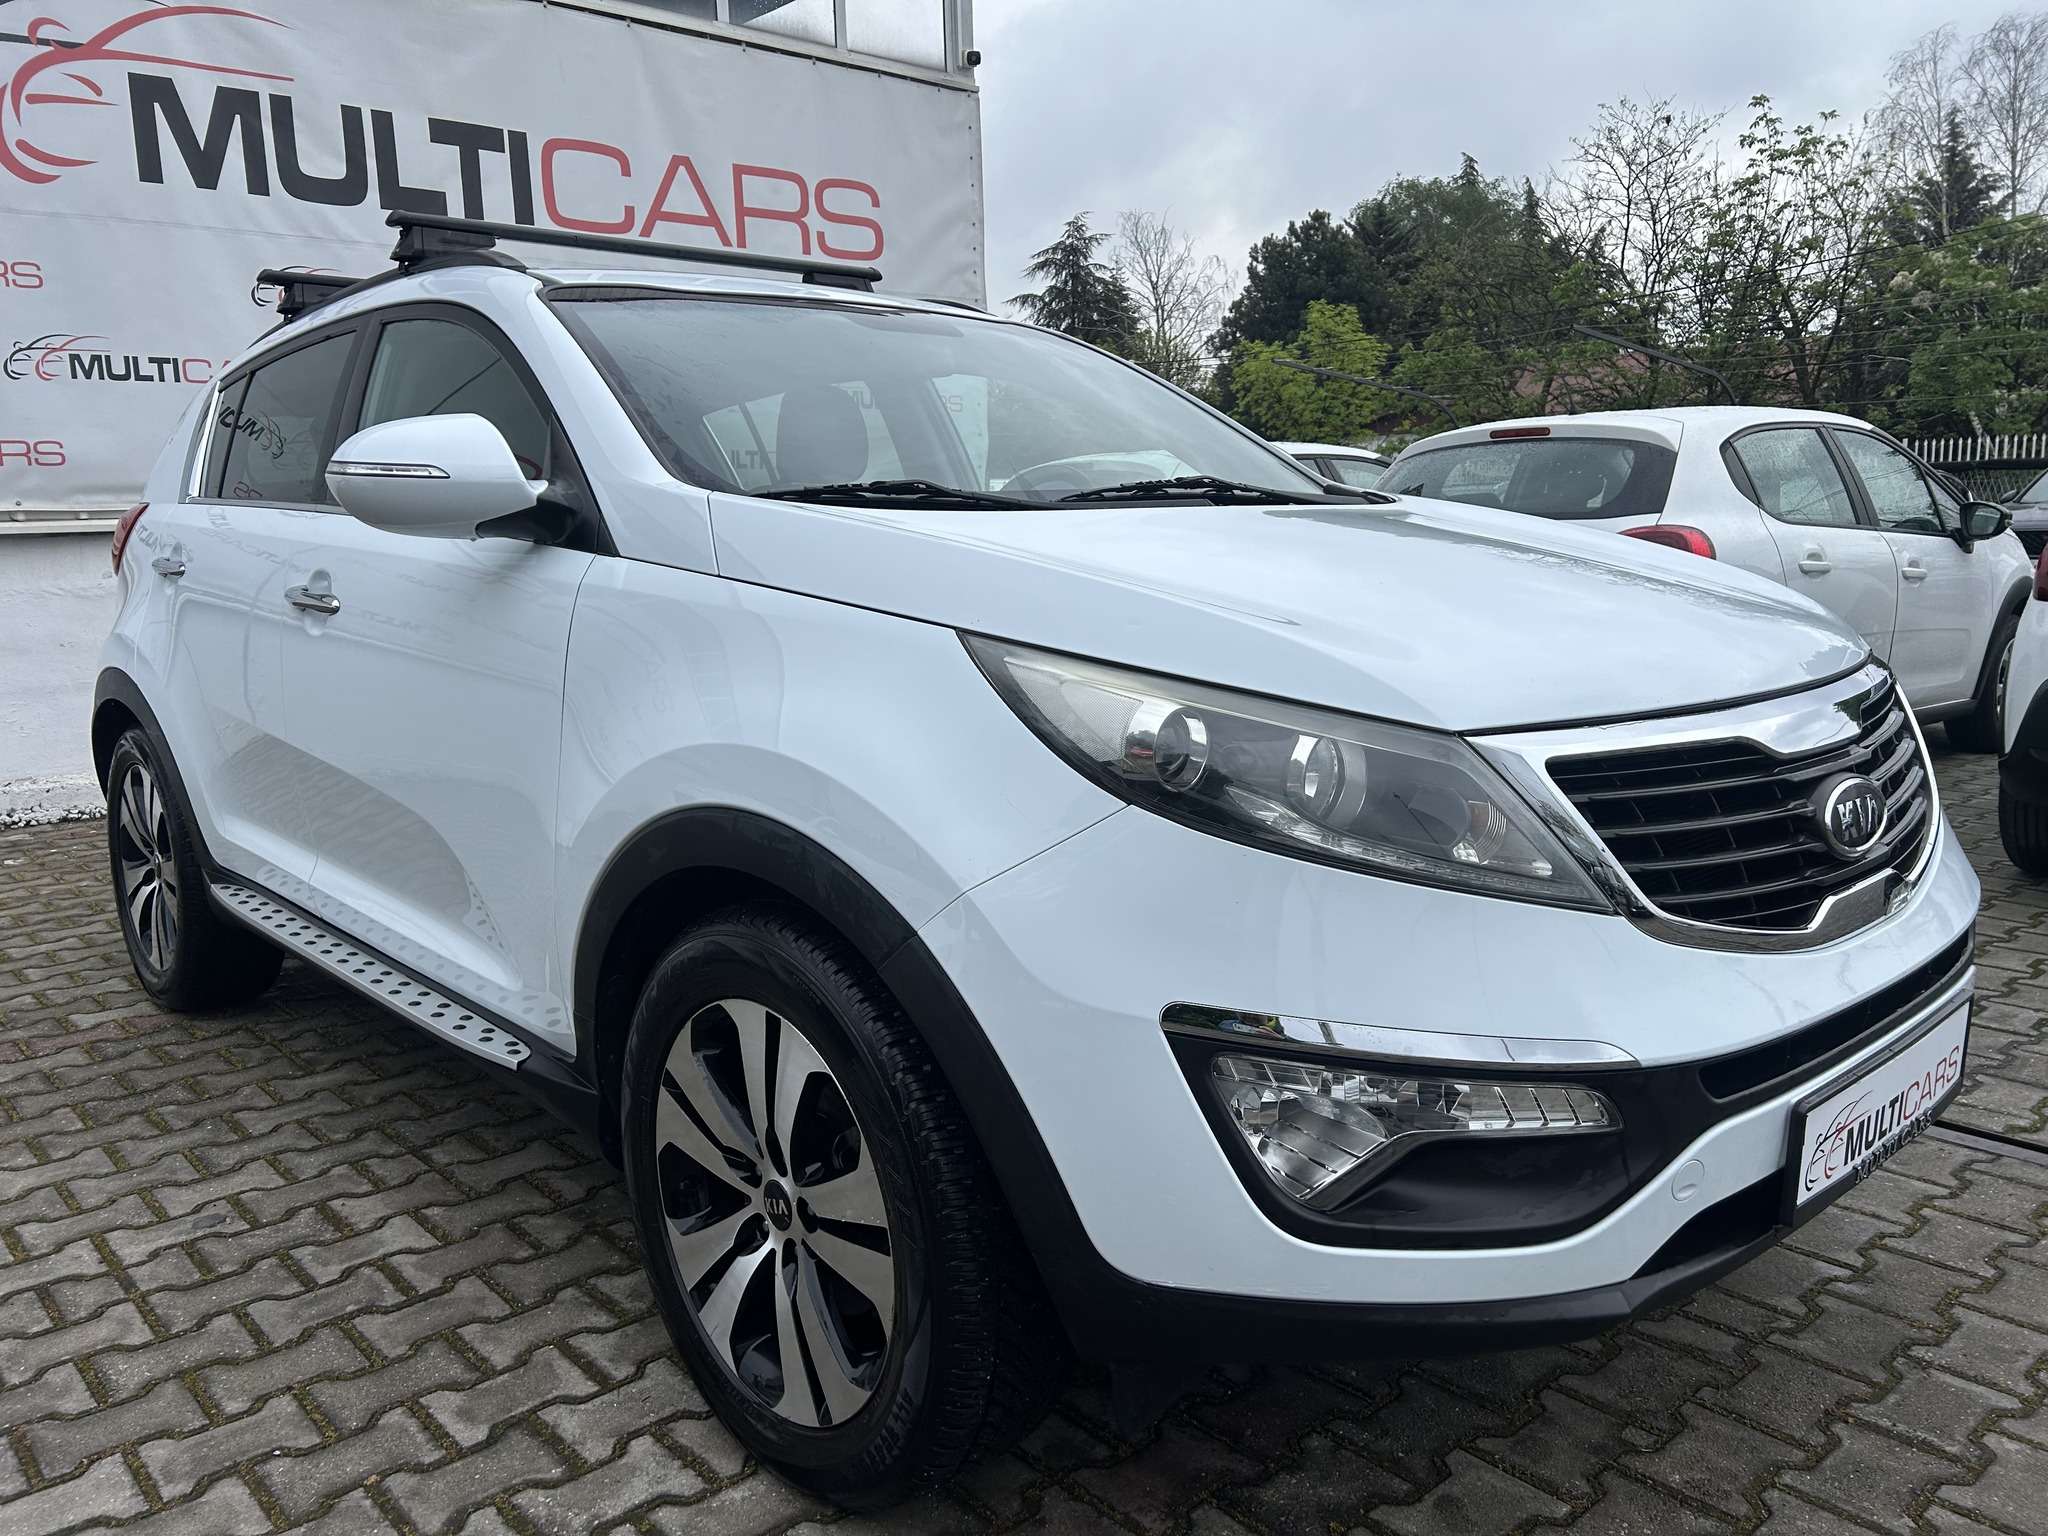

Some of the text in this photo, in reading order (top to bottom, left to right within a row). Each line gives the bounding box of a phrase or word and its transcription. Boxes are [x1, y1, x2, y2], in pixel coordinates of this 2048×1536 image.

[127, 71, 884, 261] MULTICARS
[68, 352, 231, 384] MULTIC
[1836, 793, 1879, 841] KIA
[1843, 1045, 1960, 1167] MULTICARS
[766, 1197, 789, 1216] KIA
